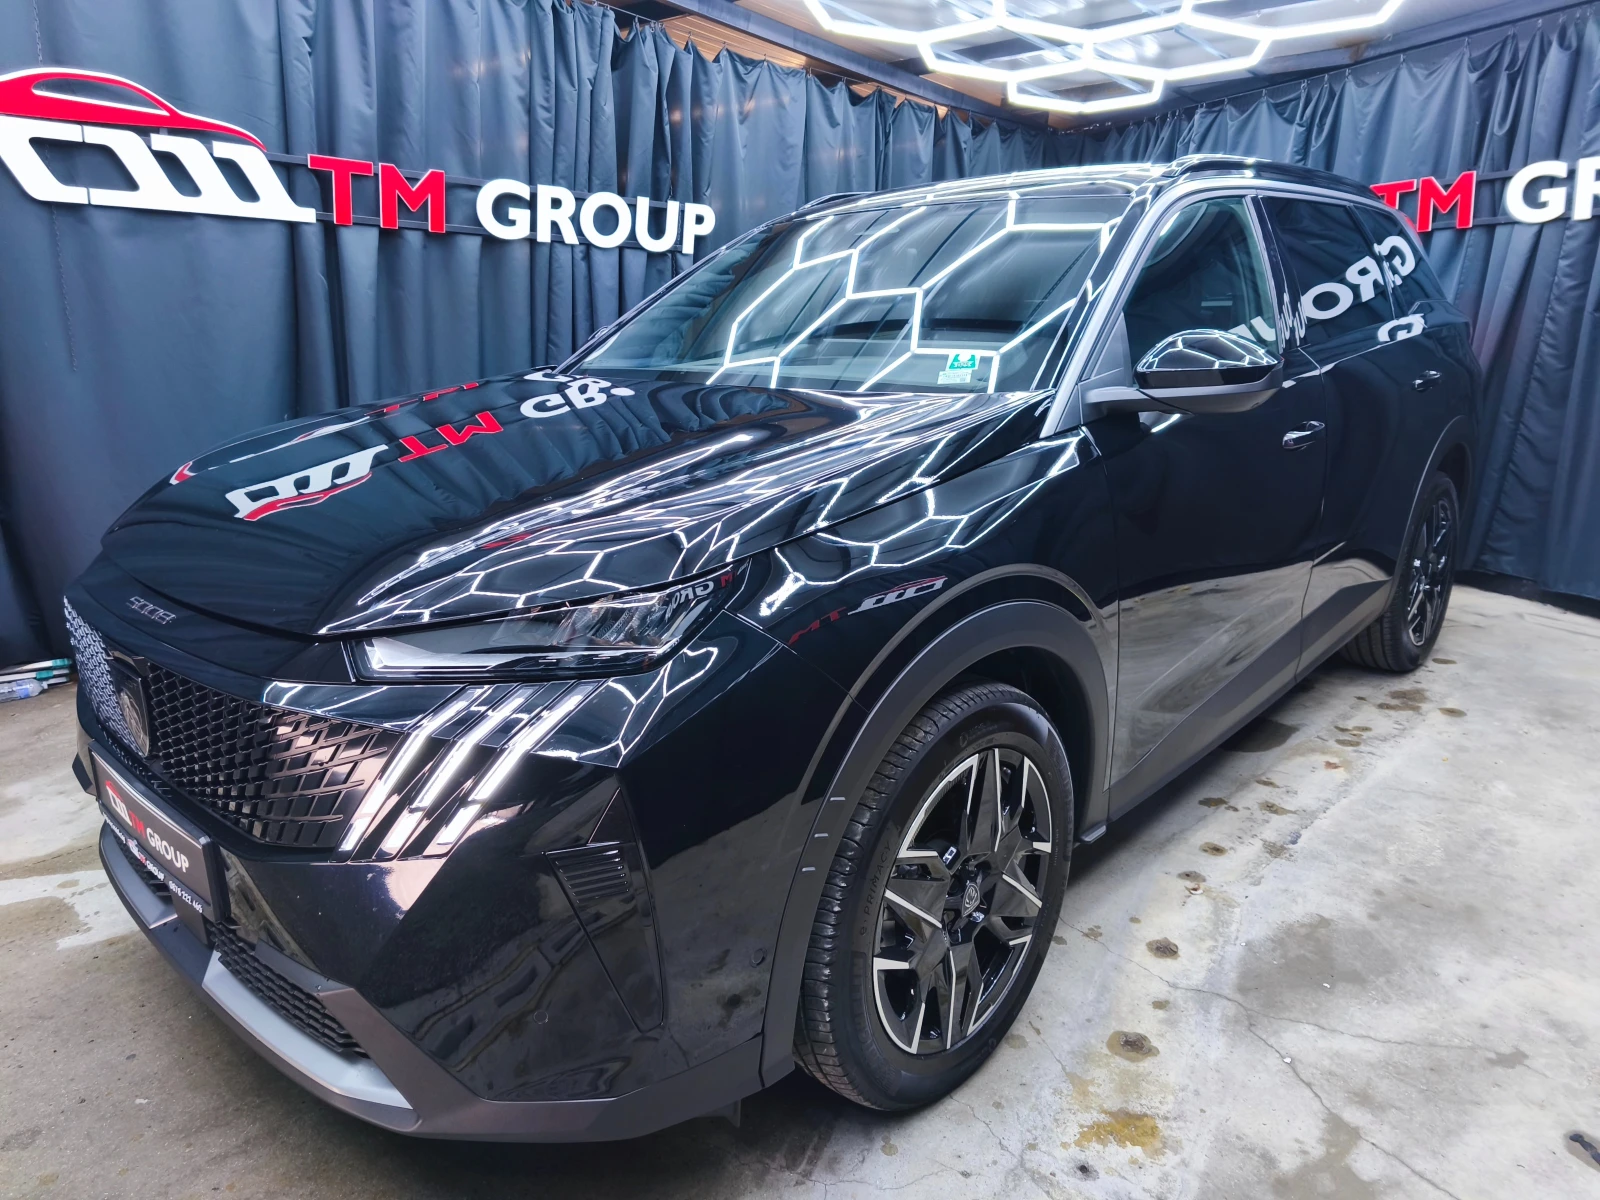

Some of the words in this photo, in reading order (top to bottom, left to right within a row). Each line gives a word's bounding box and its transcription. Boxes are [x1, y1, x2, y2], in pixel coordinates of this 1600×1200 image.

[307, 153, 446, 234] TM
[475, 178, 716, 255] GROUP
[1369, 171, 1476, 232] TM
[129, 810, 146, 839] TM
[146, 827, 189, 873] GROUP
